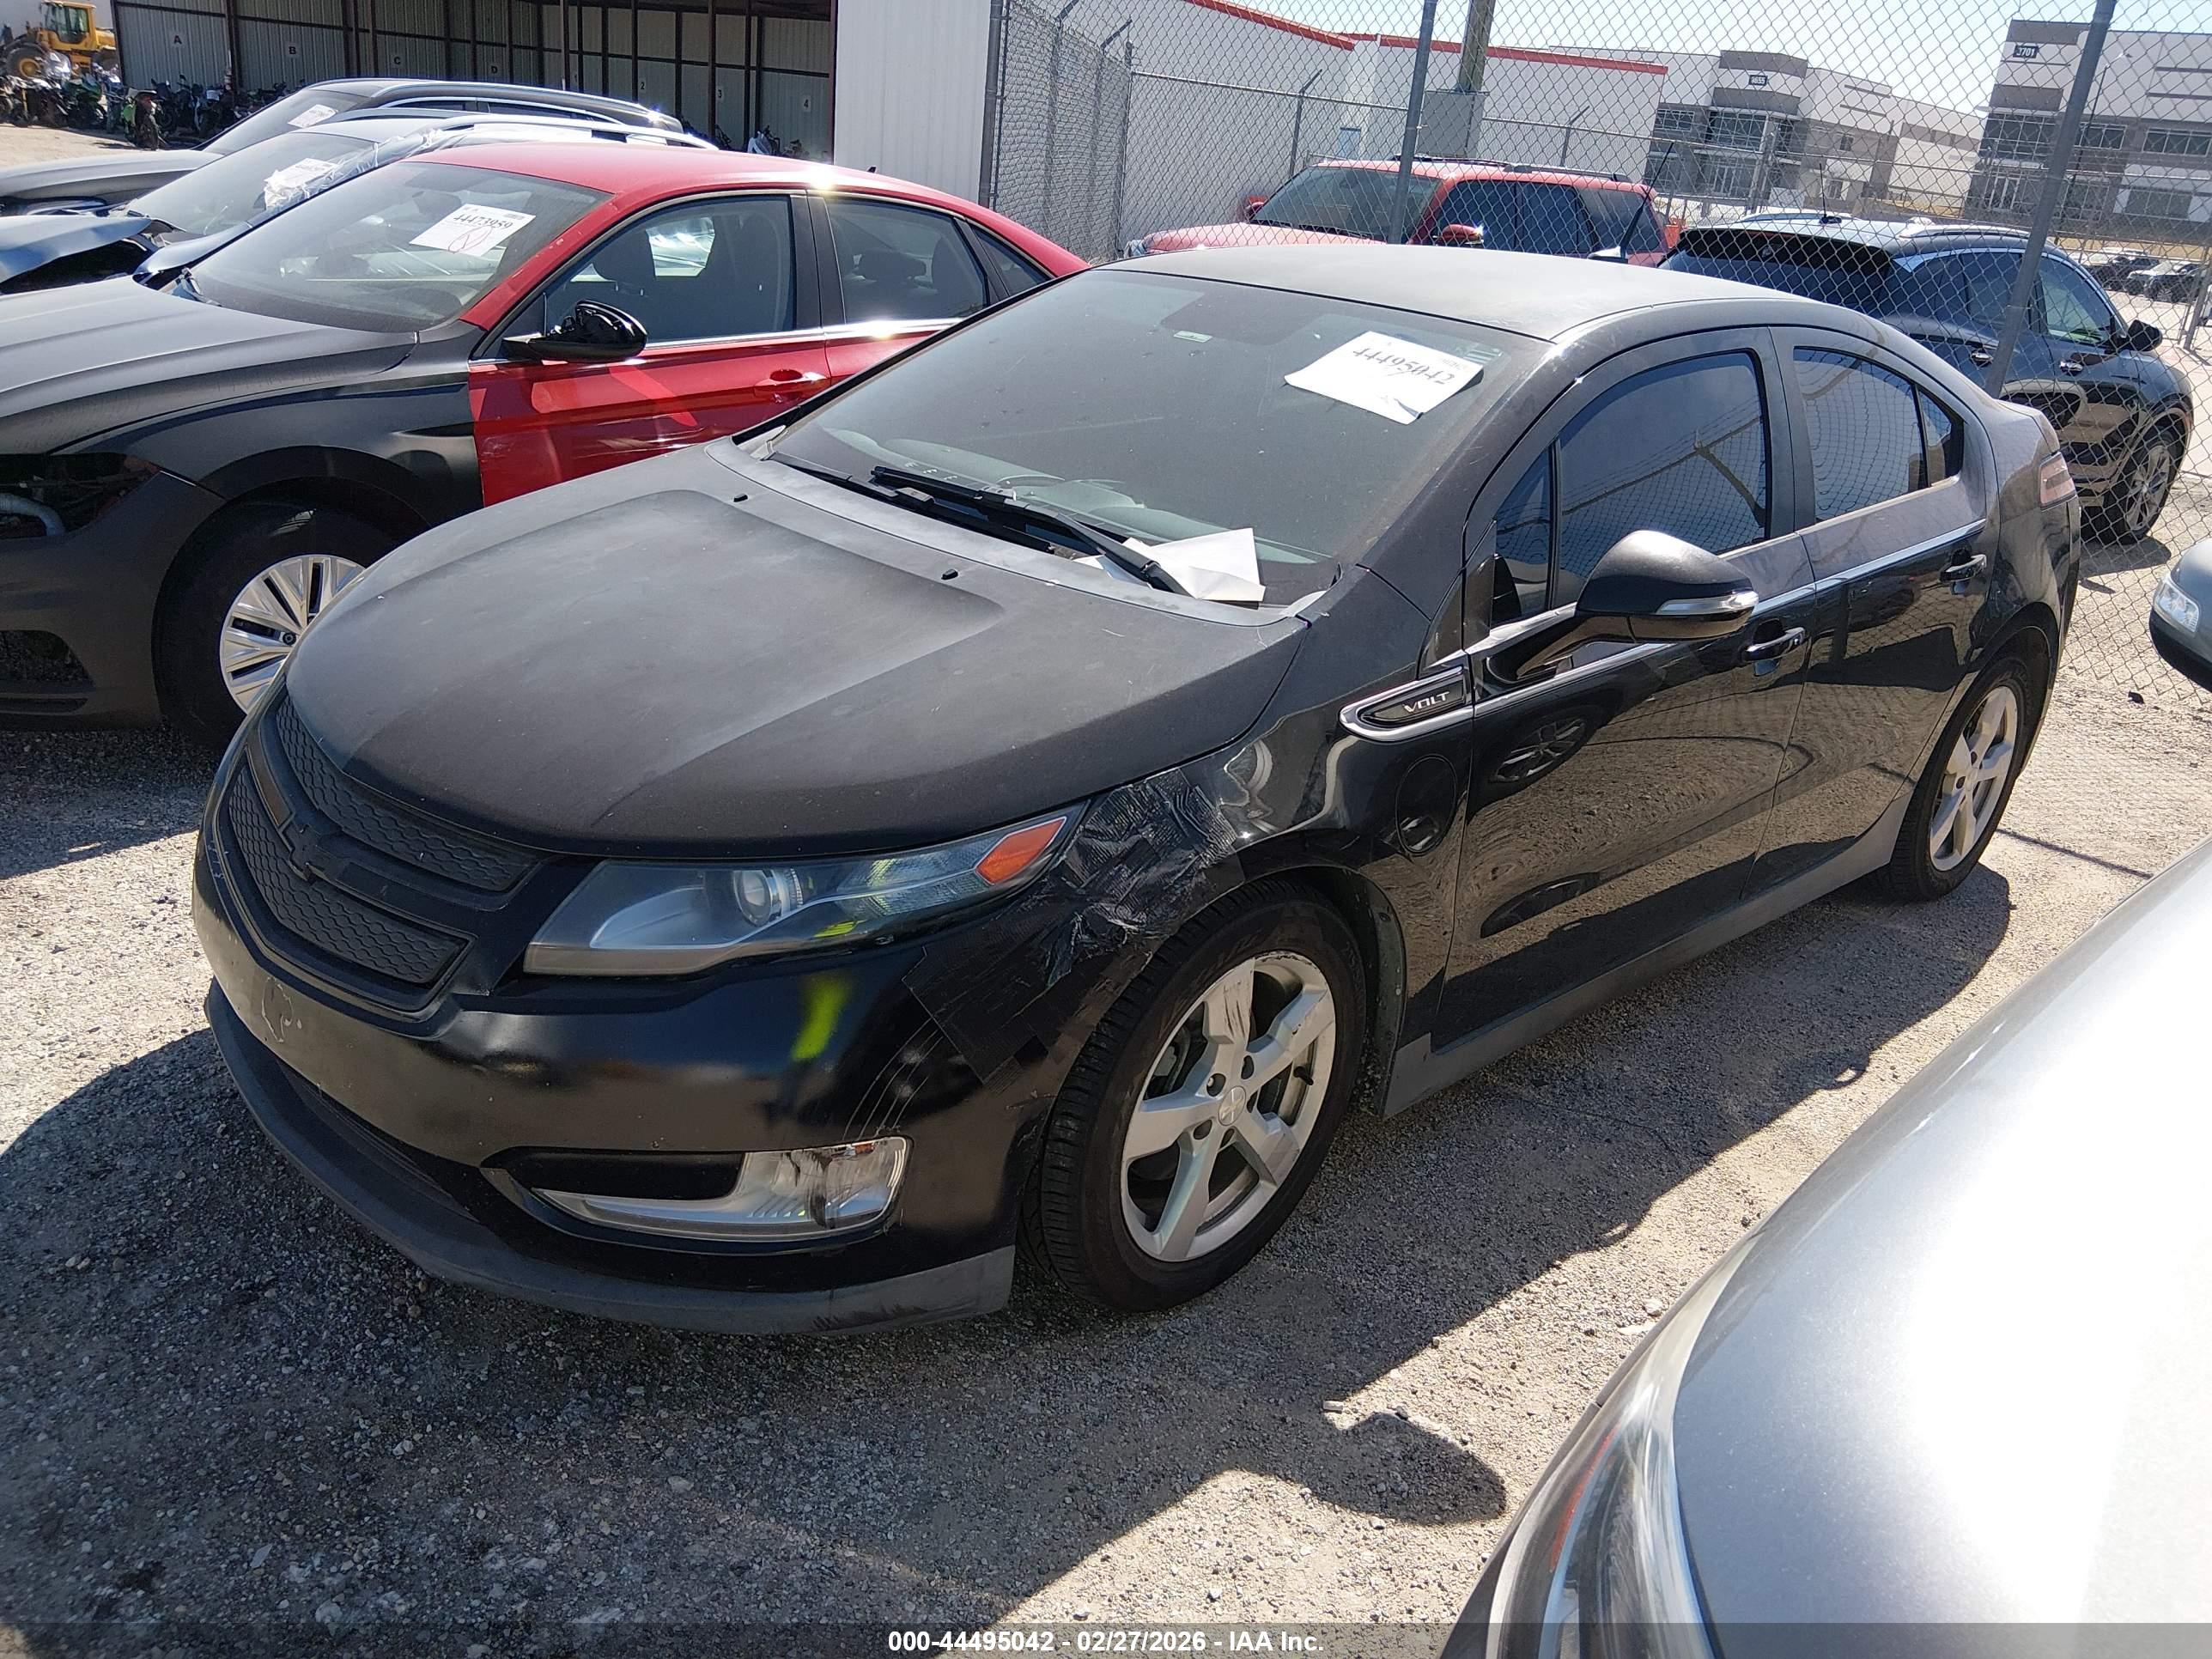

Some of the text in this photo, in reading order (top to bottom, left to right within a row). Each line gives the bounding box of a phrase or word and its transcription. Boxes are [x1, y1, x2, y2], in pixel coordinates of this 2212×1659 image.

[174, 35, 182, 44] A
[289, 46, 296, 54] B
[2016, 47, 2035, 57] 3701
[393, 56, 401, 65] C
[490, 65, 498, 74] D
[641, 82, 645, 90] 2
[718, 89, 723, 98] 3
[803, 99, 809, 108] 4
[453, 213, 514, 229] 44473959
[1352, 347, 1455, 385] 44495042
[1402, 690, 1450, 713] VOLT
